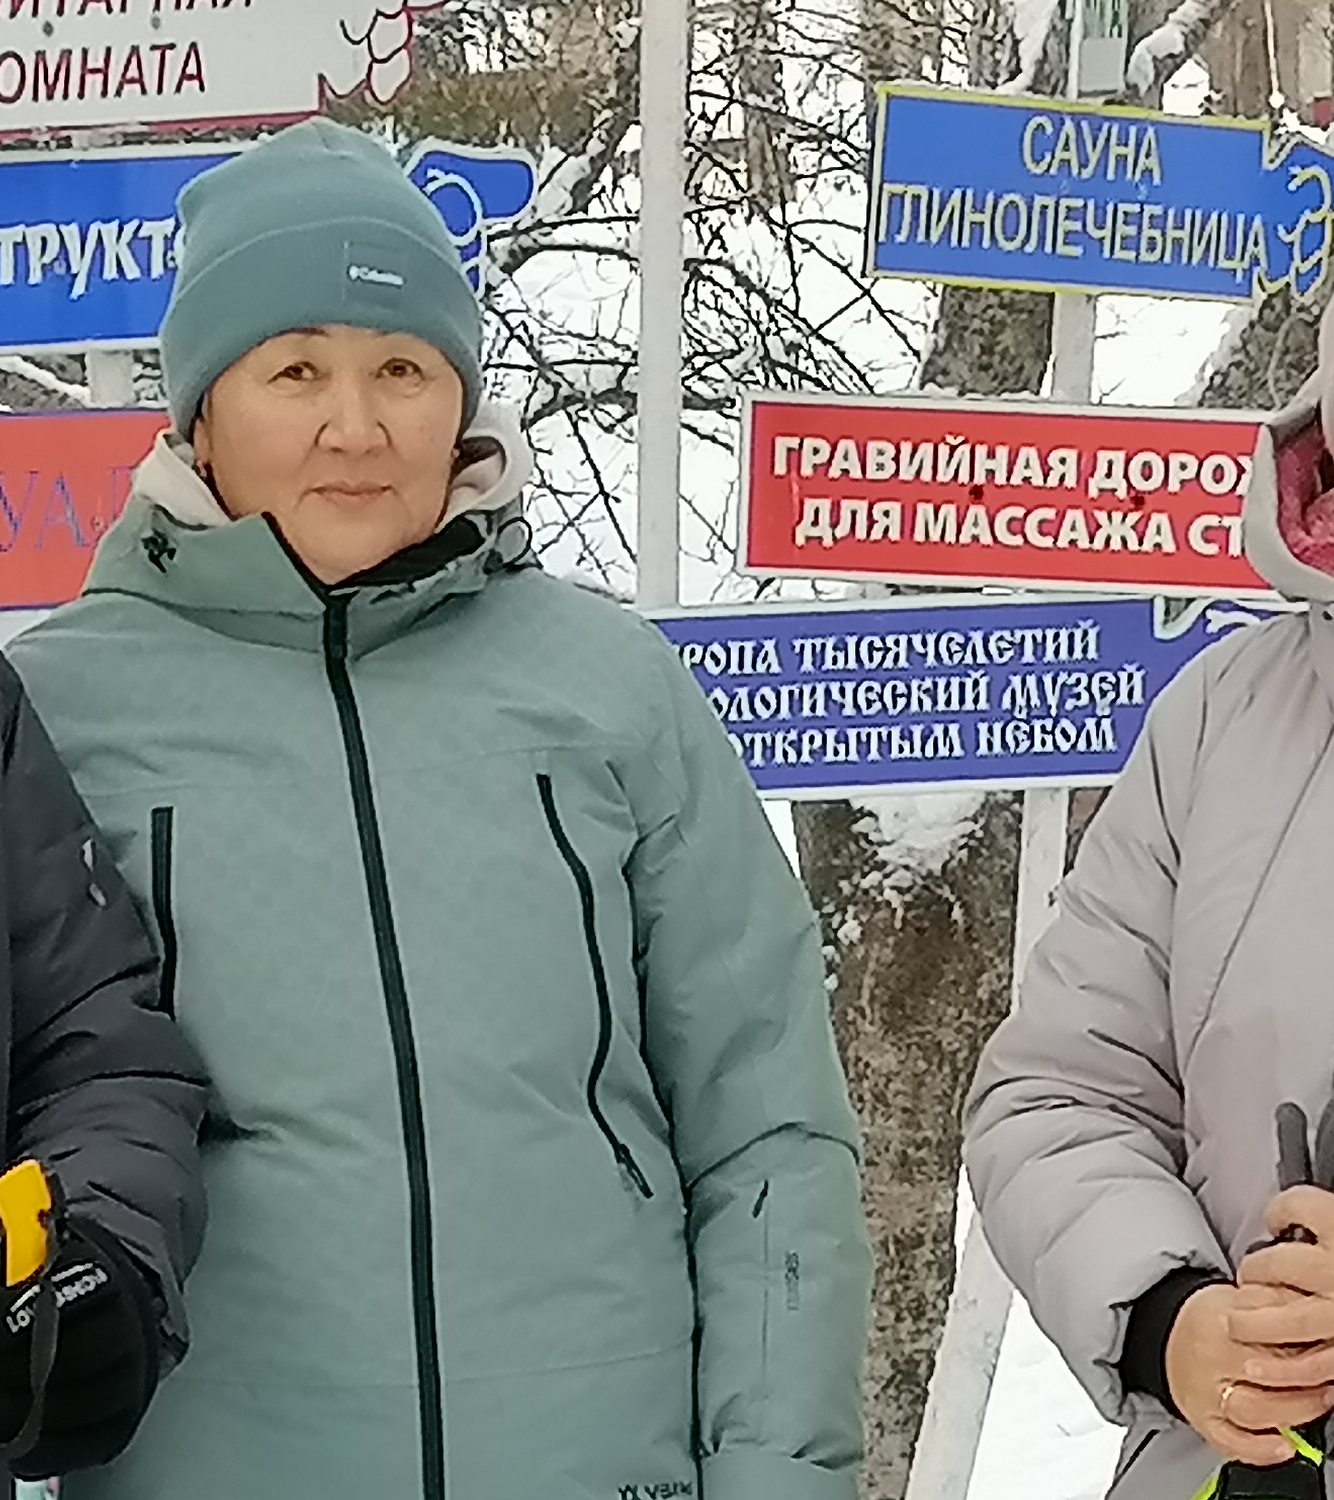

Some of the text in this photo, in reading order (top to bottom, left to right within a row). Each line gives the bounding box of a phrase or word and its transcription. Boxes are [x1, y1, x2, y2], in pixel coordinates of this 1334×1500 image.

[1022, 115, 1162, 186] САУНА
[878, 182, 1268, 284] ГЛИНОЛЕЧЕБНИЦА
[772, 435, 1079, 489] ГРАВИЙНАЯ
[795, 498, 902, 549] ДЛЯ
[913, 503, 1176, 554] МАССАЖА
[674, 619, 1101, 676] РОПА ТЫСЯЧЕЛЕТИЙ
[1002, 663, 1146, 719] МУЗЕЙ
[977, 717, 1117, 757] НЕБОМ
